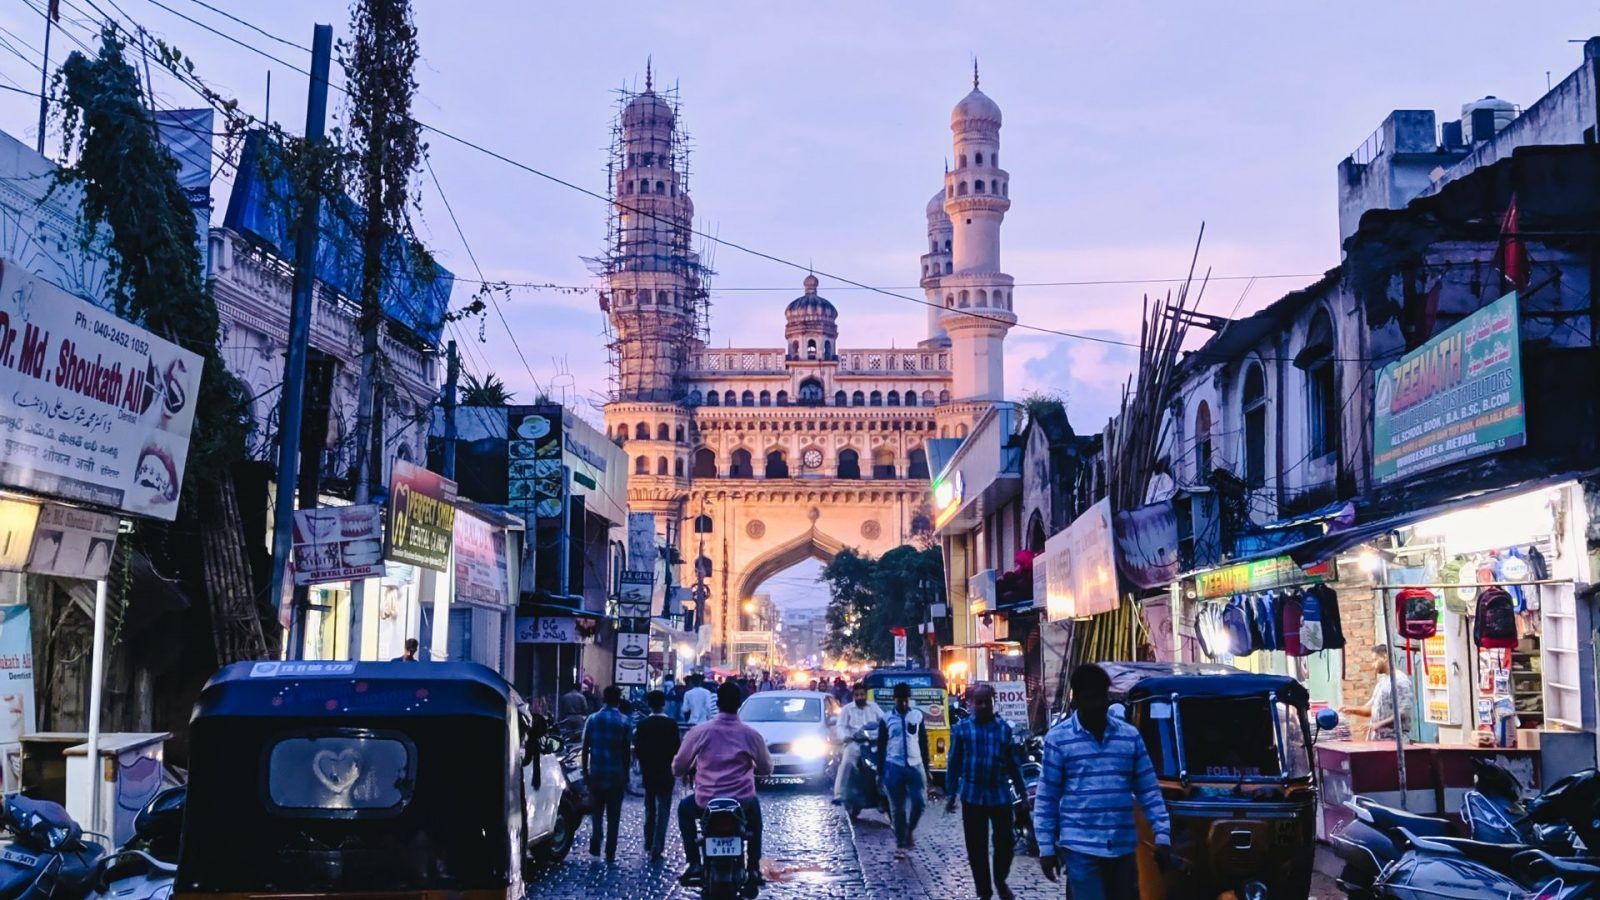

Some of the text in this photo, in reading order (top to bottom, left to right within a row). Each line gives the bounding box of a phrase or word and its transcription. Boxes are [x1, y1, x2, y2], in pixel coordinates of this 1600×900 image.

[75, 311, 87, 329] Ph
[94, 320, 129, 348] 040-2452
[131, 337, 149, 356] 1052
[55, 338, 123, 407] Shoukath
[1391, 331, 1461, 413] ZEENATH
[1441, 367, 1512, 411] DISTRIBUTORS
[1483, 391, 1510, 411] B.COM
[1446, 432, 1477, 450] RETAIL
[409, 525, 430, 550] DENTAL
[310, 567, 372, 579] DENTAL CLINIC
[9, 672, 32, 681] Dentist
